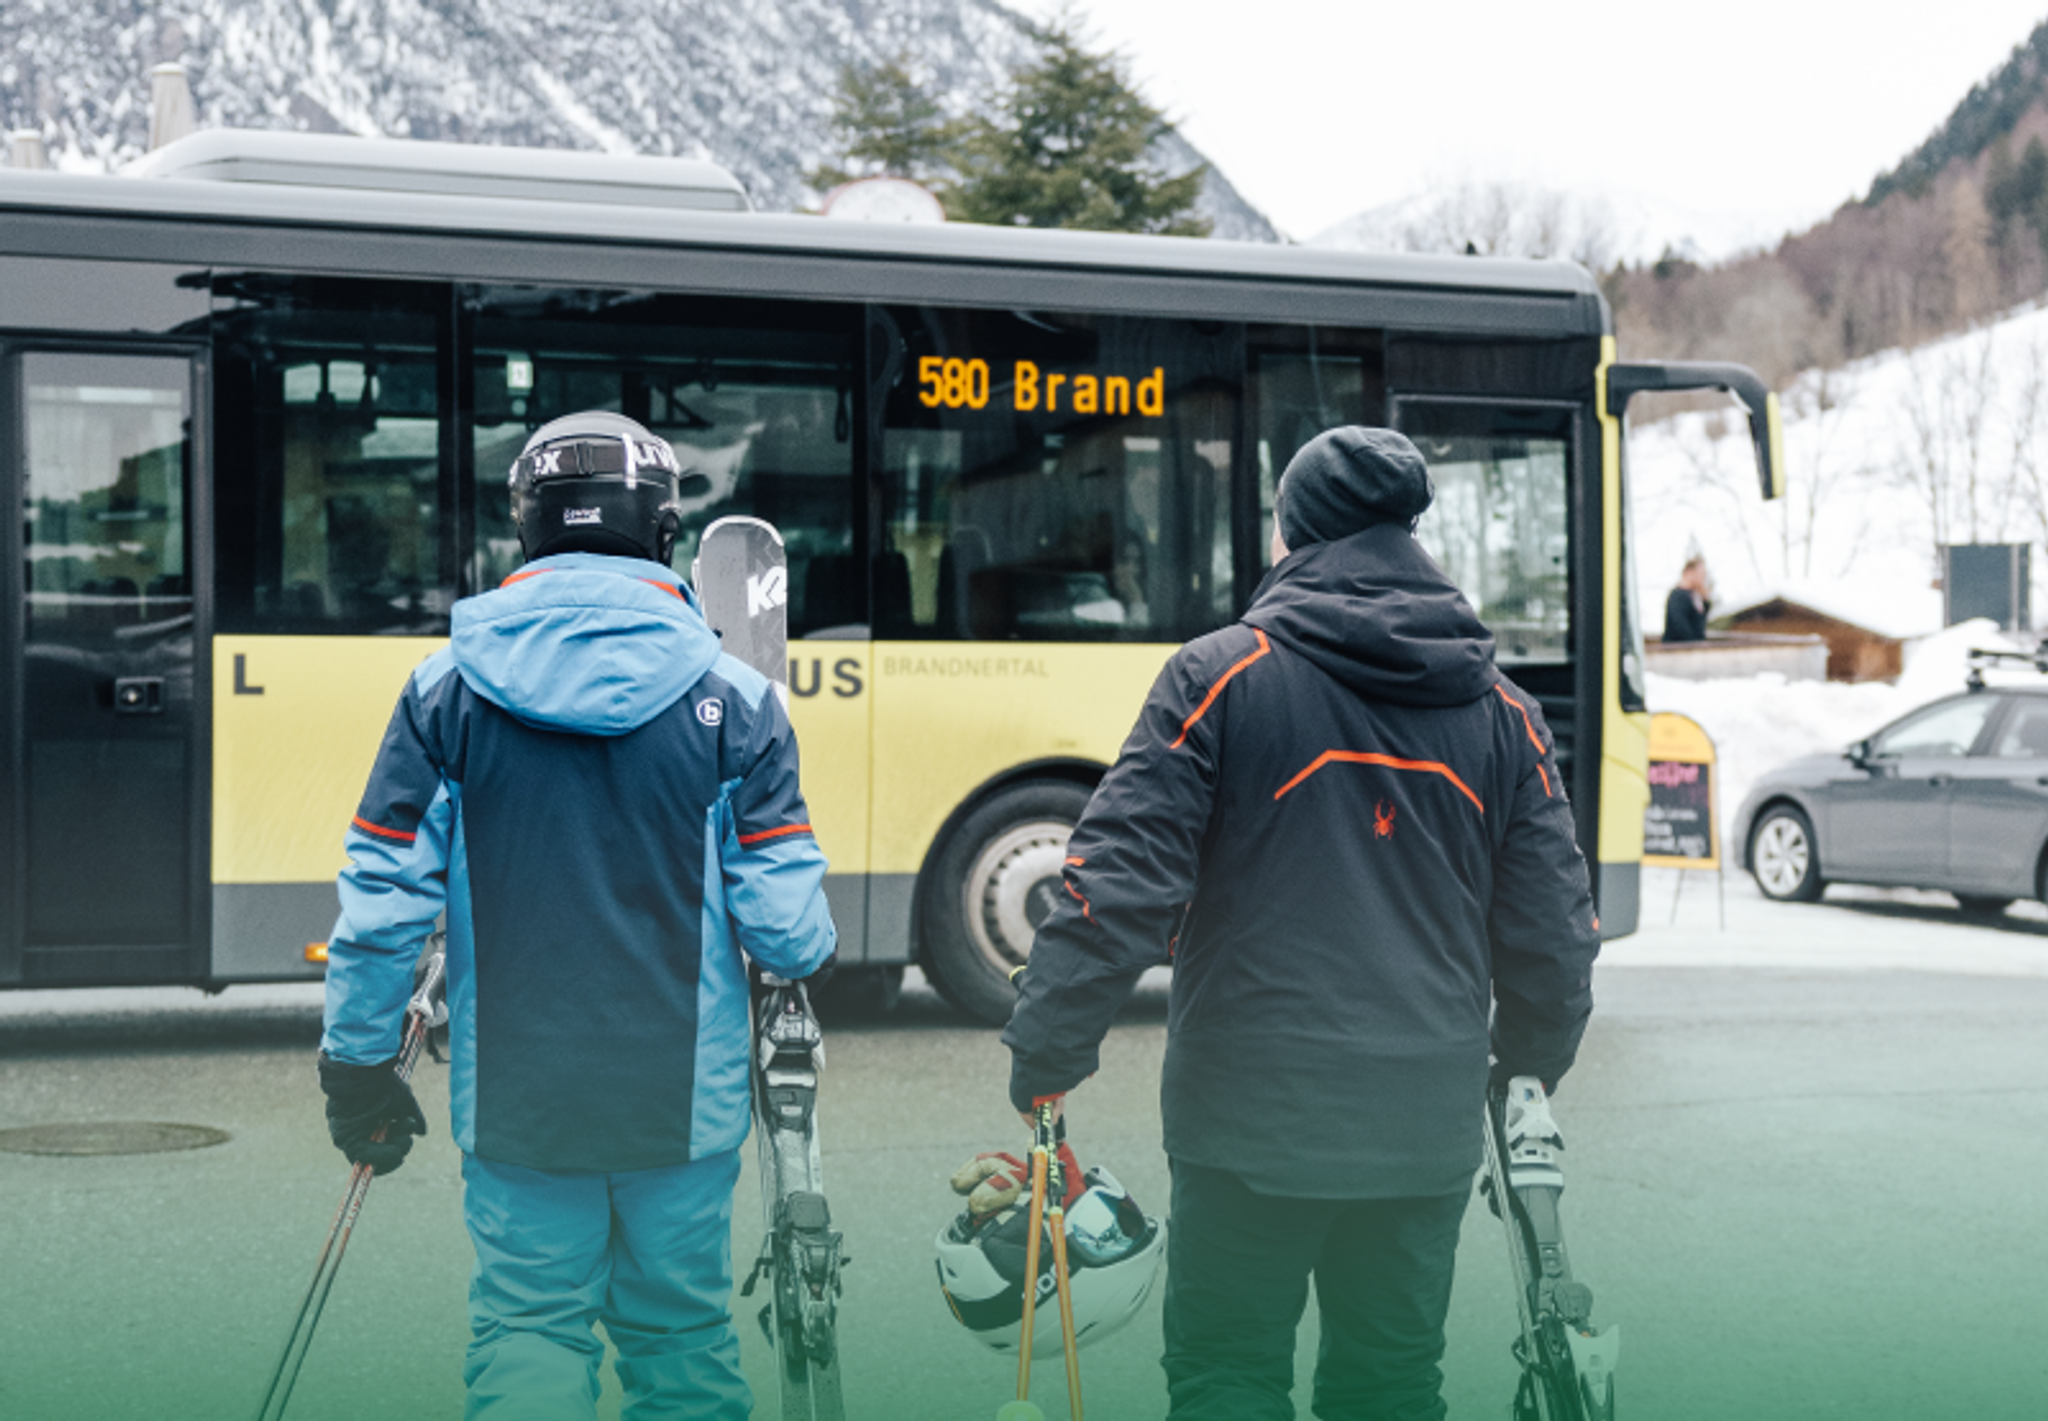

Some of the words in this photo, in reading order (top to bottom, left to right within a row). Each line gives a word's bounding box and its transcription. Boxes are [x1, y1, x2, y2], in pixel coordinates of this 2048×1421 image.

[918, 356, 990, 410] 580
[1014, 360, 1164, 417] Brand
[233, 653, 265, 696] L
[883, 656, 1049, 677] BRANDNERTAL
